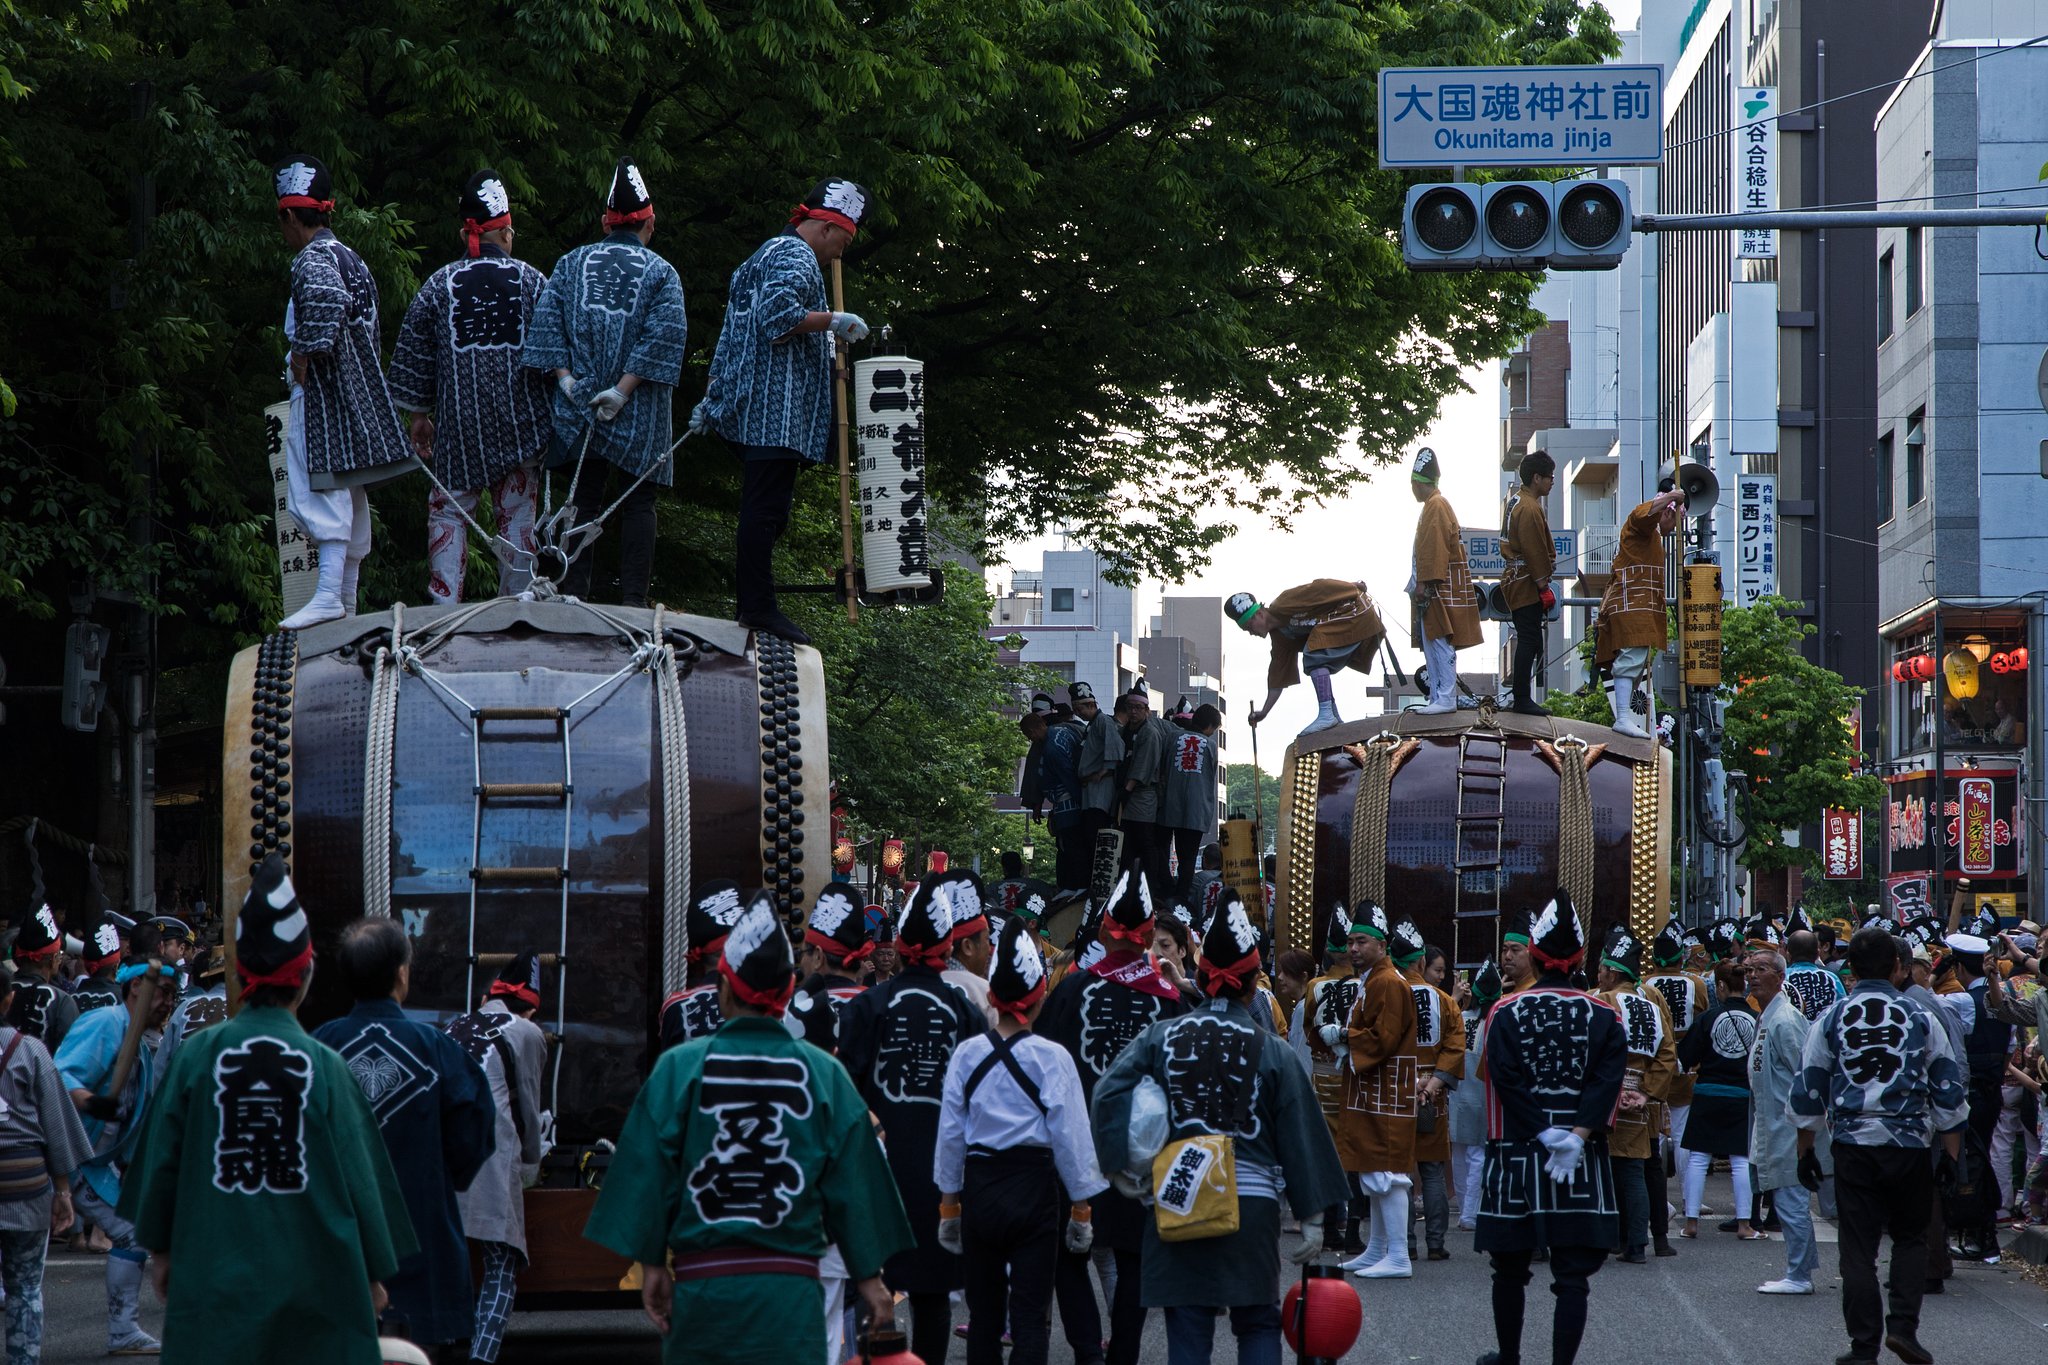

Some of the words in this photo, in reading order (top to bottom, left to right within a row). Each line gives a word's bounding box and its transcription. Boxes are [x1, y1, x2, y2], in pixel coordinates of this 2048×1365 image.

[1394, 84, 1651, 122] 大国魂神社前
[1434, 128, 1554, 149] Okunitama
[1563, 128, 1612, 153] jinja
[1746, 123, 1767, 208] 谷合稔生
[1742, 482, 1760, 610] 宮西クリニッ
[1964, 784, 1991, 803] 居酒屋
[1967, 803, 1989, 862] 山茶花
[1841, 996, 1906, 1086] 小田分
[1161, 1146, 1206, 1208] 御太鼓
